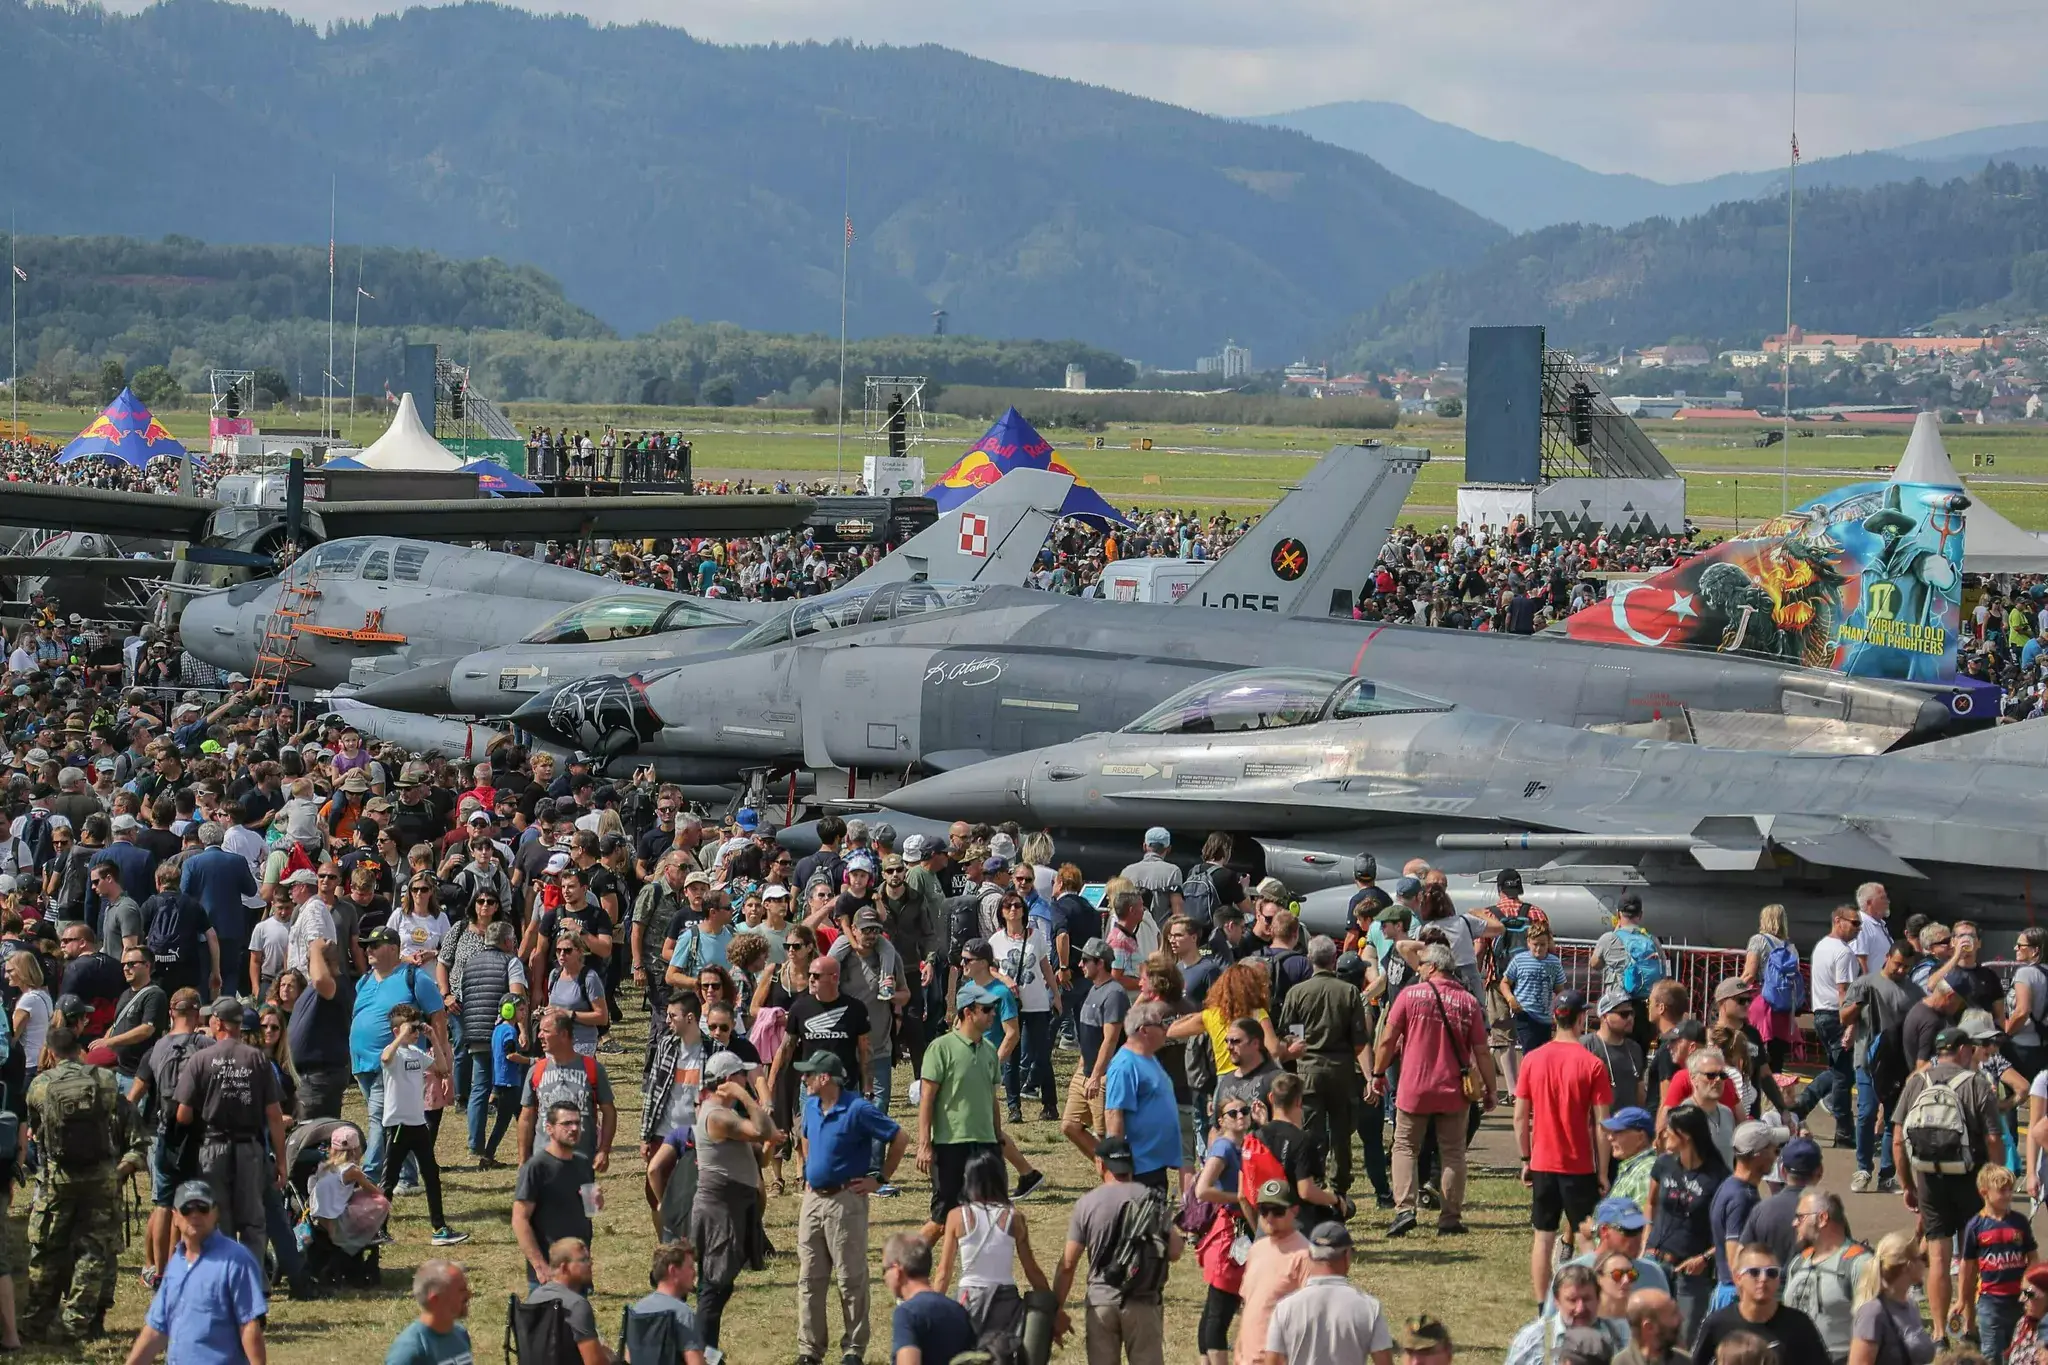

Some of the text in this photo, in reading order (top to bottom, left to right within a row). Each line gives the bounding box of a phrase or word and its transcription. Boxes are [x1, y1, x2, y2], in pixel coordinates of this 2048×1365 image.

[983, 438, 1017, 458] Bull
[1023, 438, 1049, 458] Red
[1171, 582, 1190, 591] MIET
[1866, 616, 1945, 642] TRIBUTE TO OLD
[1839, 624, 1945, 655] PHANTOM PHIGHTERS
[1112, 766, 1140, 774] RESCUE
[155, 954, 176, 962] PUMA
[804, 1031, 849, 1040] HONDA
[539, 1068, 588, 1088] UNIVERSITY
